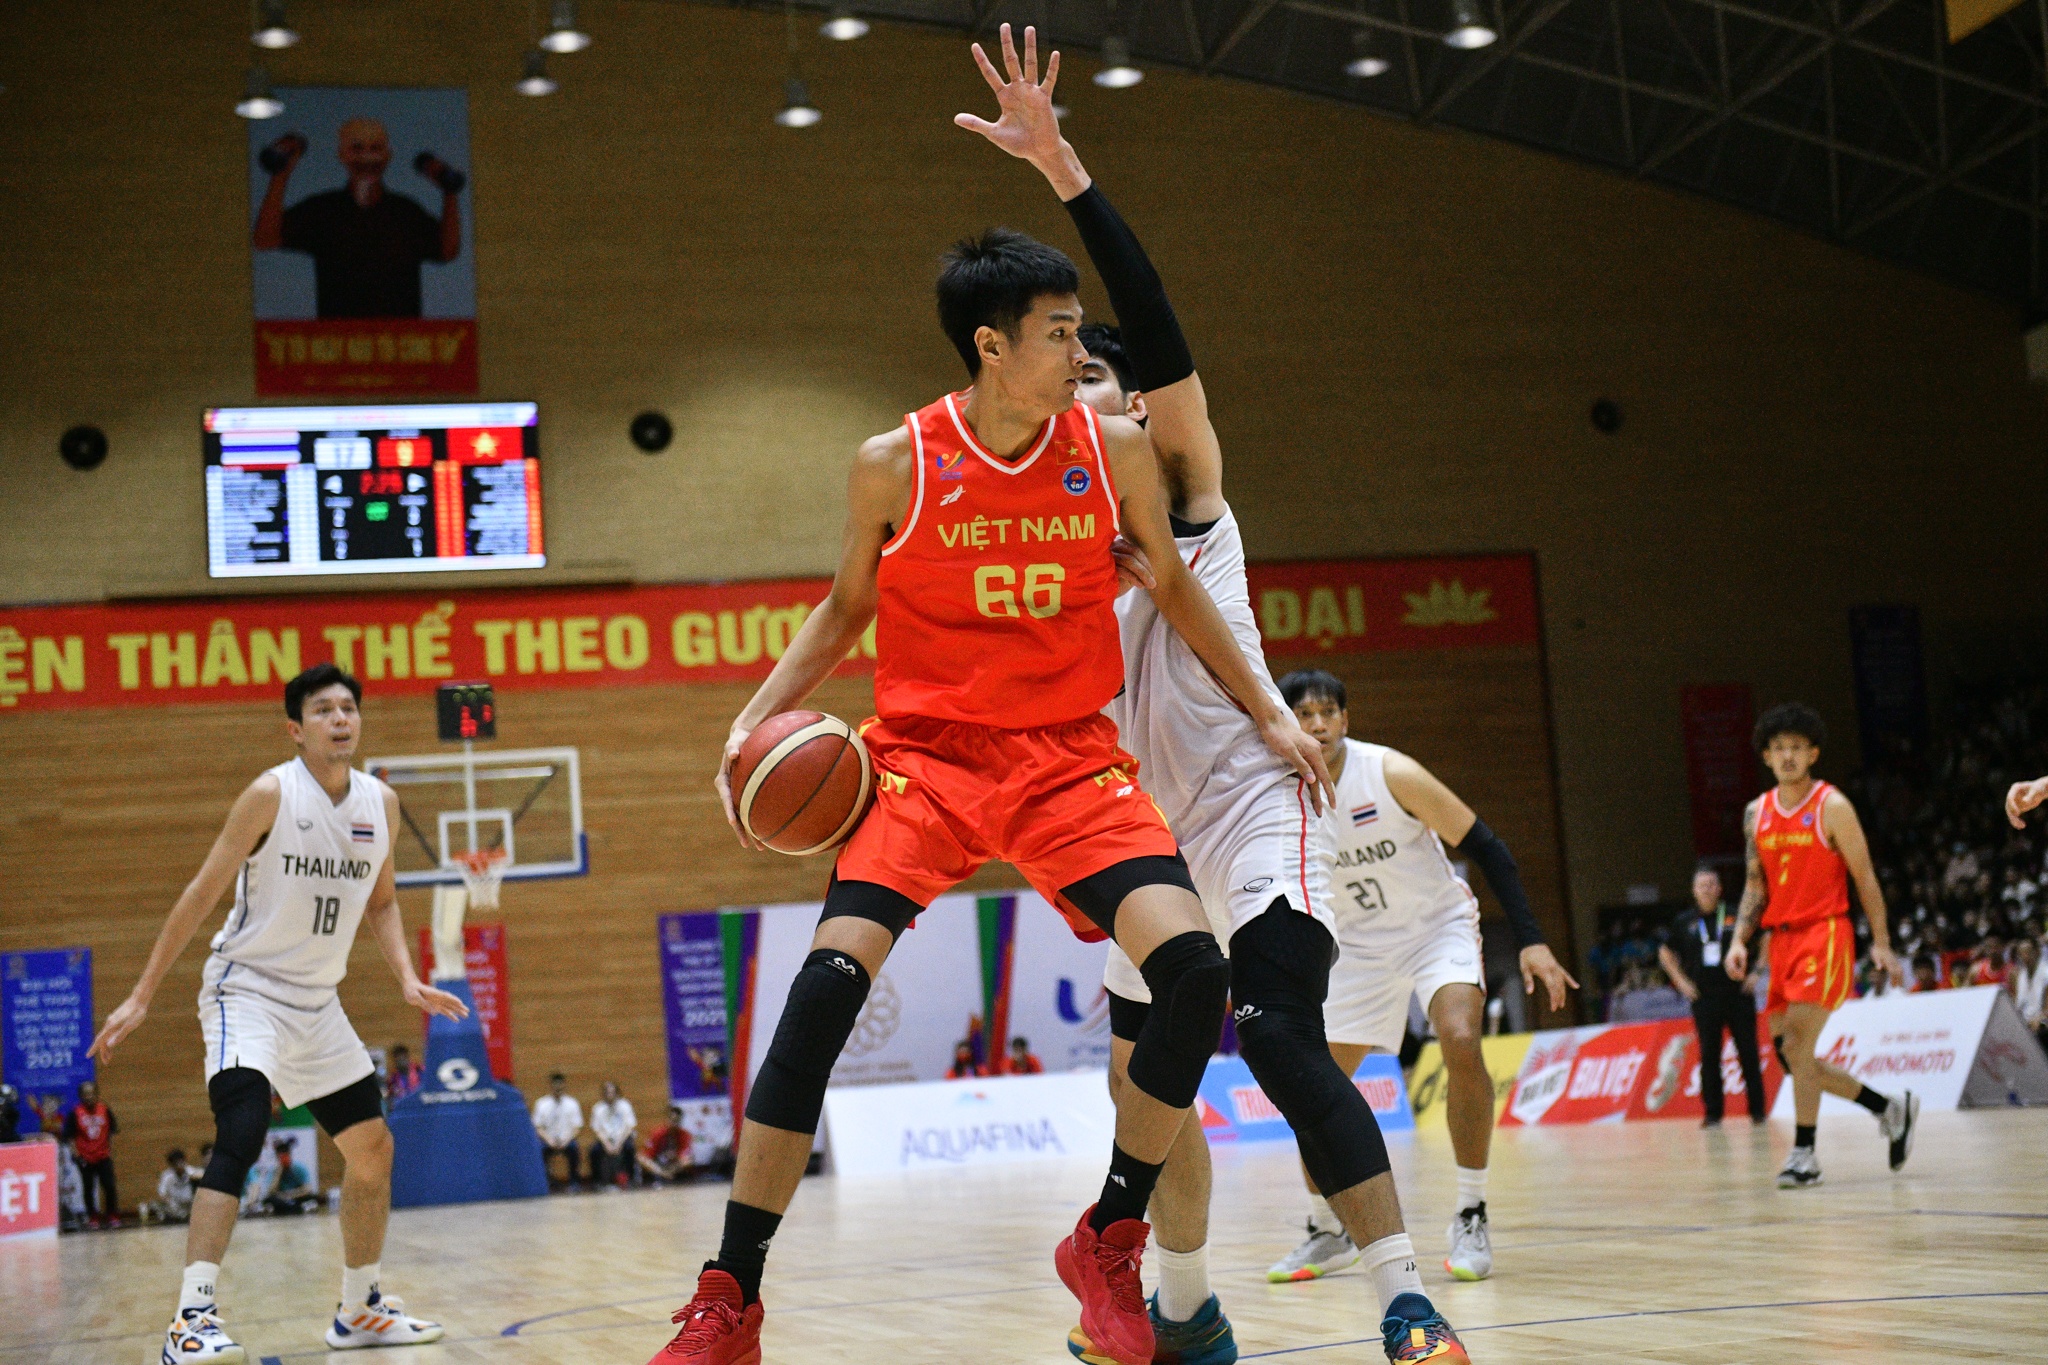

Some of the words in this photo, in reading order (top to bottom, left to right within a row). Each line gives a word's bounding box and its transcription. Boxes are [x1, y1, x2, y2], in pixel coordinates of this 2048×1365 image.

[937, 514, 1012, 551] VIỆT
[1020, 513, 1095, 543] NAM
[974, 562, 1066, 619] 66
[107, 618, 299, 690] THÂN
[323, 600, 456, 680] THỂ
[474, 613, 650, 676] THEO
[671, 603, 878, 668] GƯƠ
[1260, 586, 1366, 649] ĐẠI
[281, 853, 372, 881] THAILAND
[1345, 875, 1388, 911] 27
[312, 895, 341, 937] 18
[26, 1049, 73, 1070] 2021
[900, 1117, 1068, 1167] AQUAFINA
